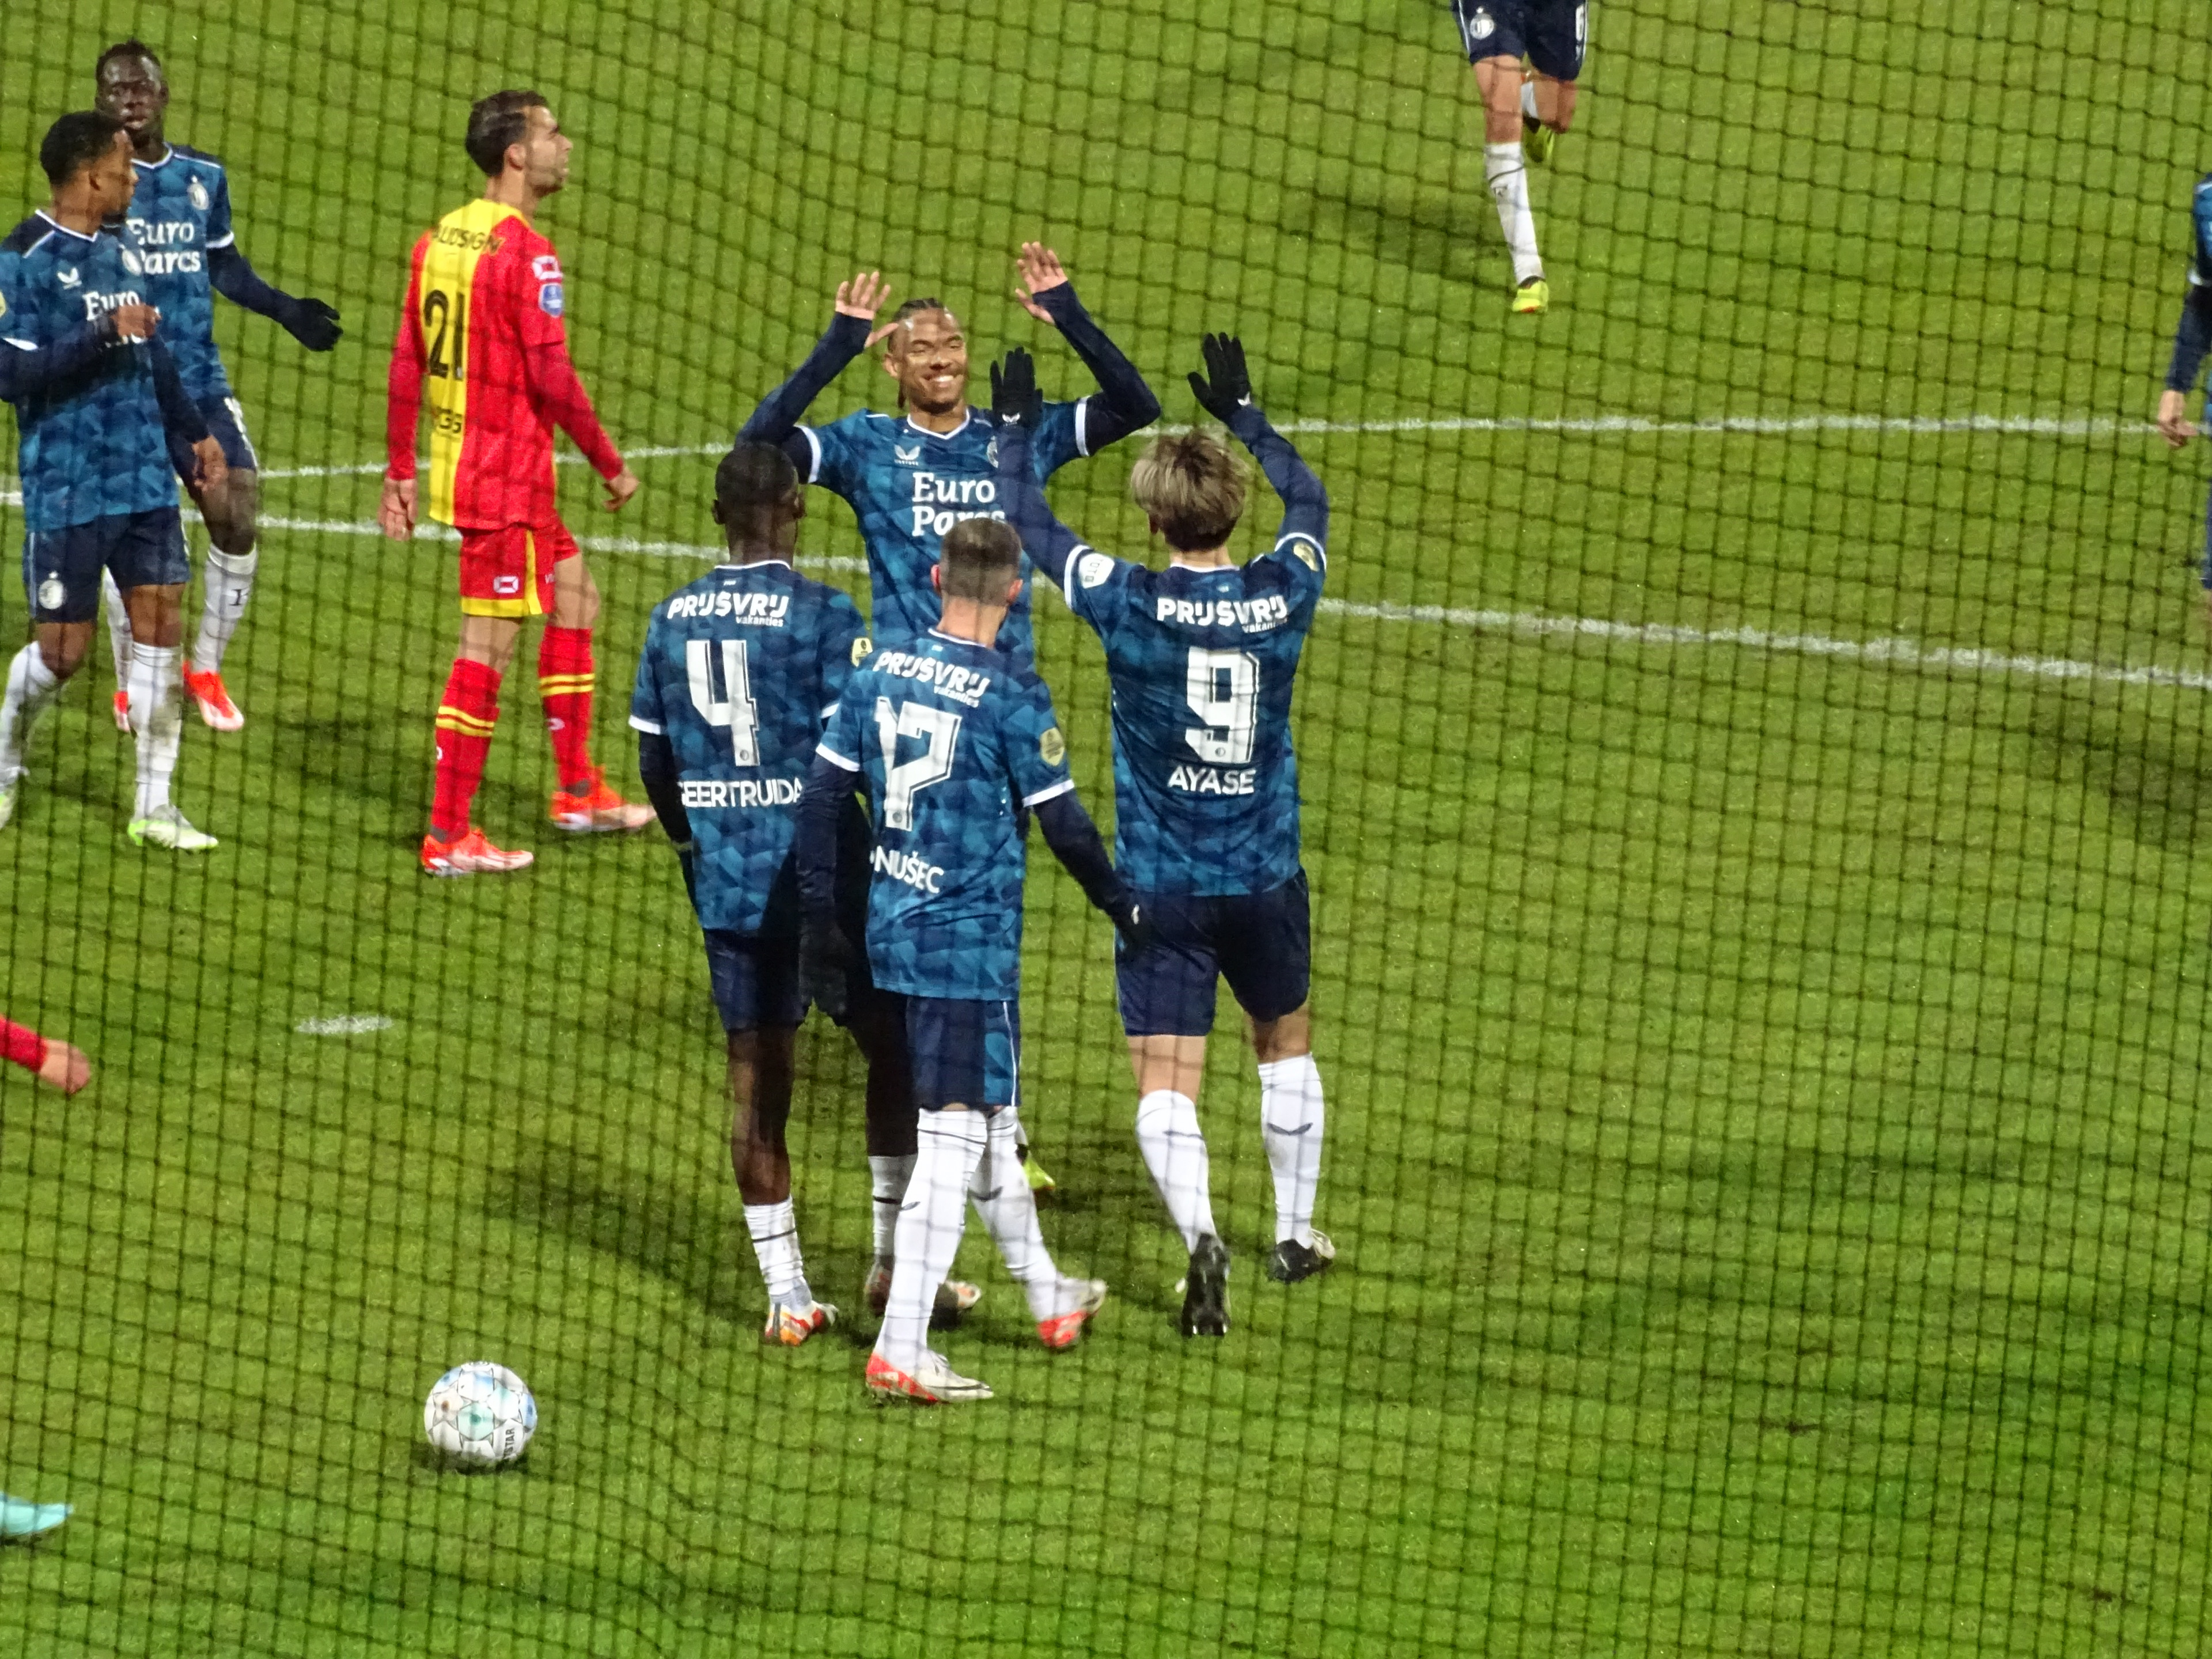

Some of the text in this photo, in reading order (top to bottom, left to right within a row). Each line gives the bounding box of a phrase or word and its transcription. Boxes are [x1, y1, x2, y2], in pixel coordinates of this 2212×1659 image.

[139, 249, 202, 275] arcs
[423, 289, 465, 382] 21
[911, 472, 995, 503] Euro
[736, 615, 784, 627] vakanties
[1241, 619, 1288, 634] vakant
[686, 639, 760, 766] 4
[1185, 646, 1260, 764] 9
[874, 696, 963, 832] 17
[1167, 764, 1257, 795] AYASE
[869, 845, 945, 894] NUŠEC
